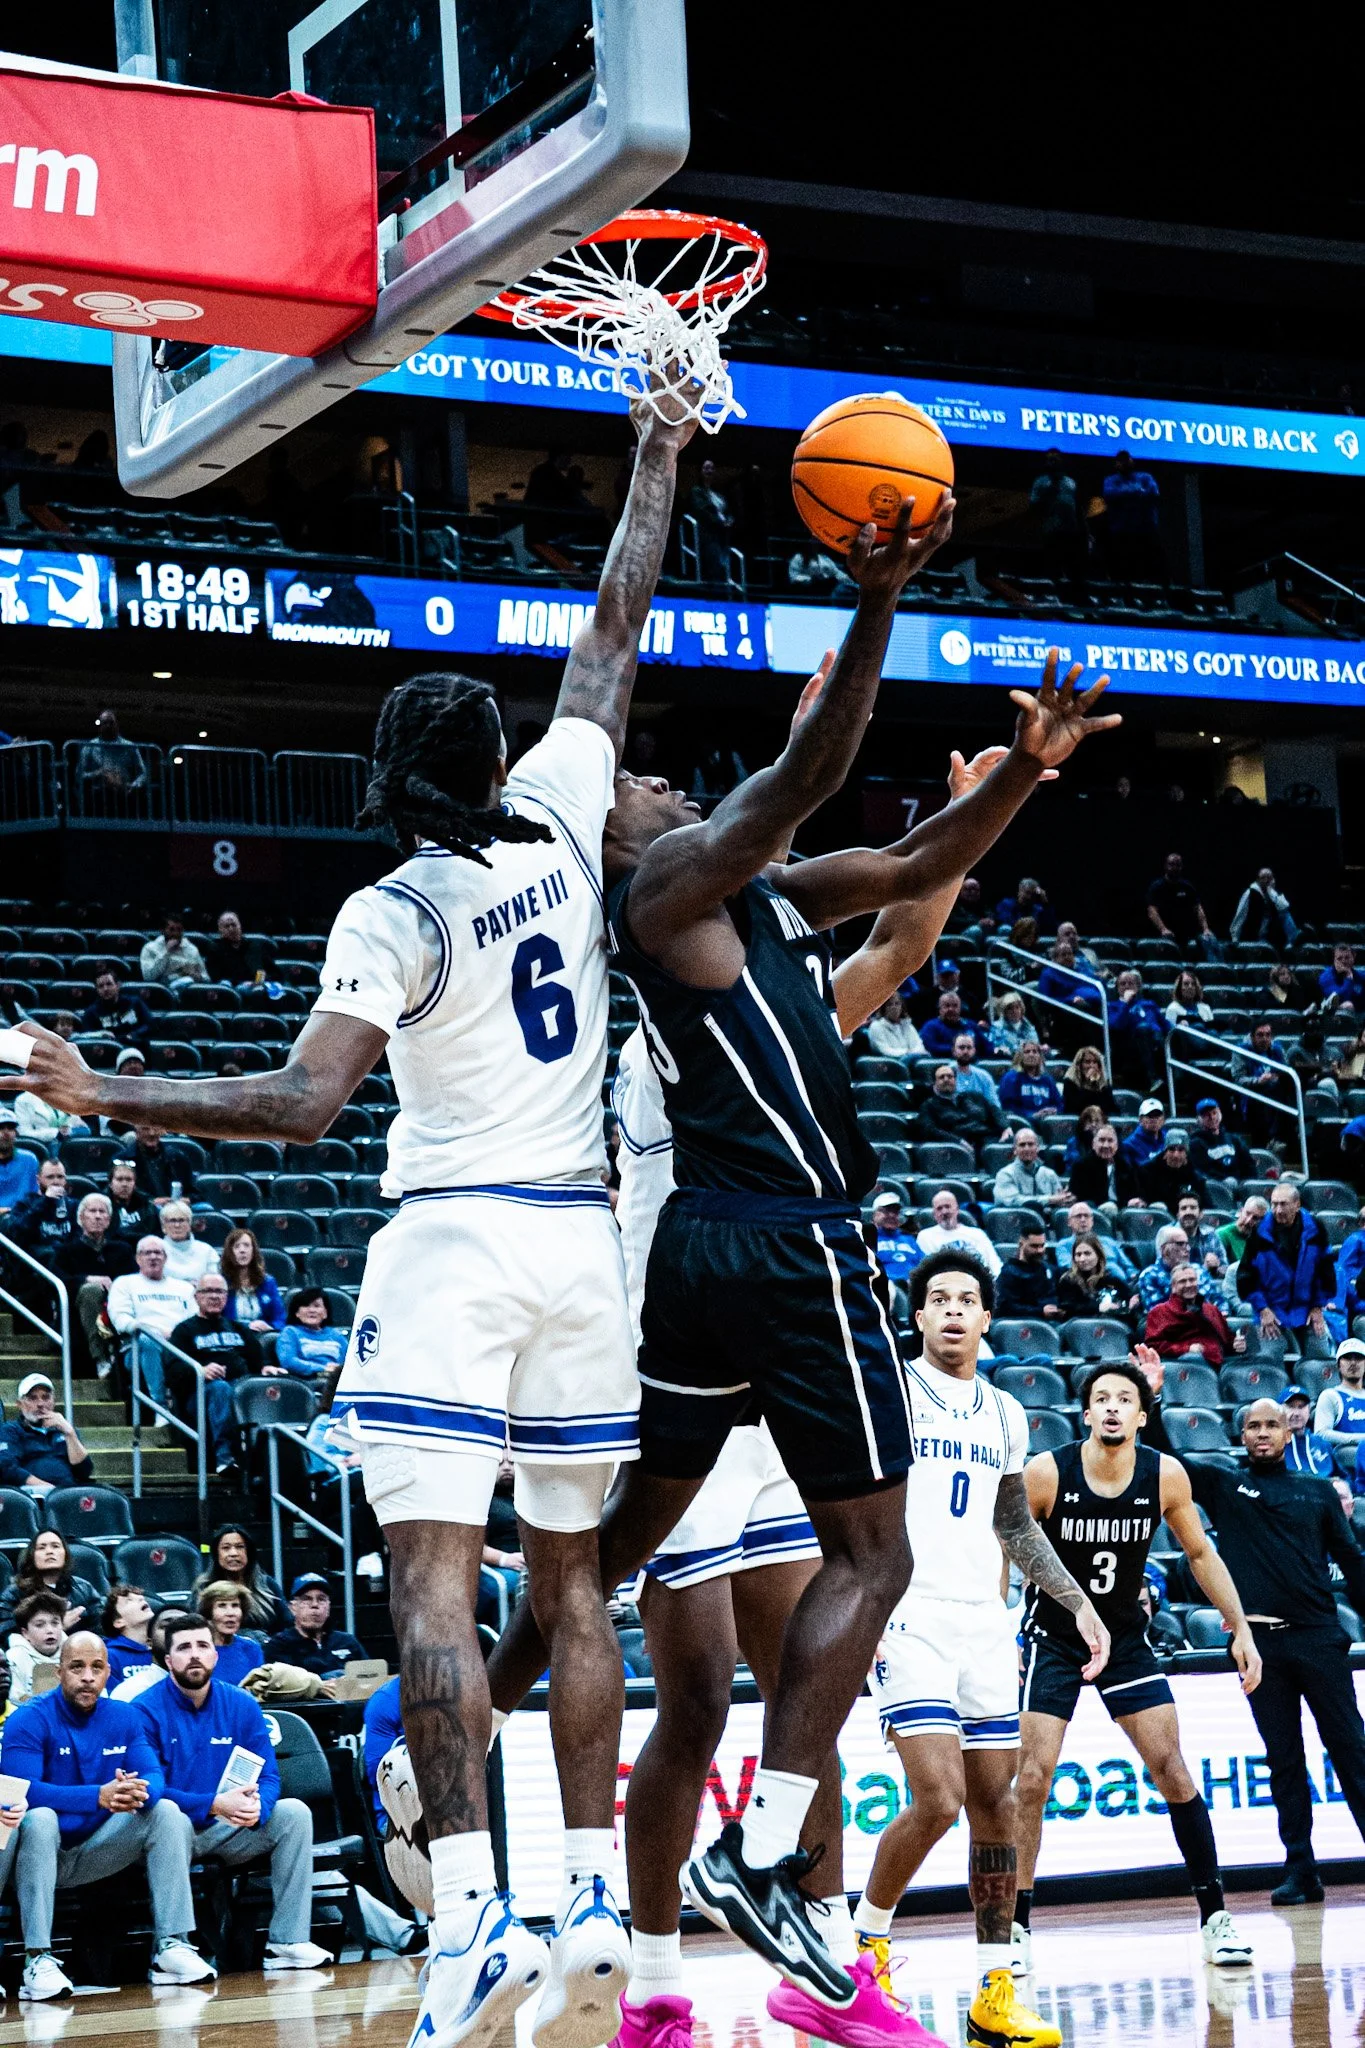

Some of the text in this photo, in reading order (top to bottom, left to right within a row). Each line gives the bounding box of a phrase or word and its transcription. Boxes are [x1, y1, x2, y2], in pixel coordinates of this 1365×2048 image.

[406, 351, 631, 392] GOT YOUR BACK
[1020, 407, 1121, 438] PETER'S
[1125, 416, 1177, 442] GOT
[1180, 421, 1249, 449] YOUR
[1253, 427, 1319, 454] BACK
[136, 562, 250, 606] 18:49
[127, 600, 260, 634] 1ST HALF
[272, 622, 391, 648] MONMOUTH
[425, 597, 455, 636] 0
[738, 612, 749, 635] 1
[736, 637, 754, 660] 4
[973, 641, 1018, 659] PETER
[1086, 644, 1190, 675] PETER'S
[1193, 650, 1247, 677] GOT
[1250, 654, 1321, 682] YOUR
[901, 798, 919, 829] 7
[213, 840, 239, 876] 8
[471, 868, 569, 950] PAYNE III
[511, 932, 578, 1064] 6
[971, 1443, 1001, 1470] HALL
[949, 1470, 971, 1518] 0
[1061, 1517, 1152, 1543] MONMOUTH
[1089, 1550, 1118, 1595] 3
